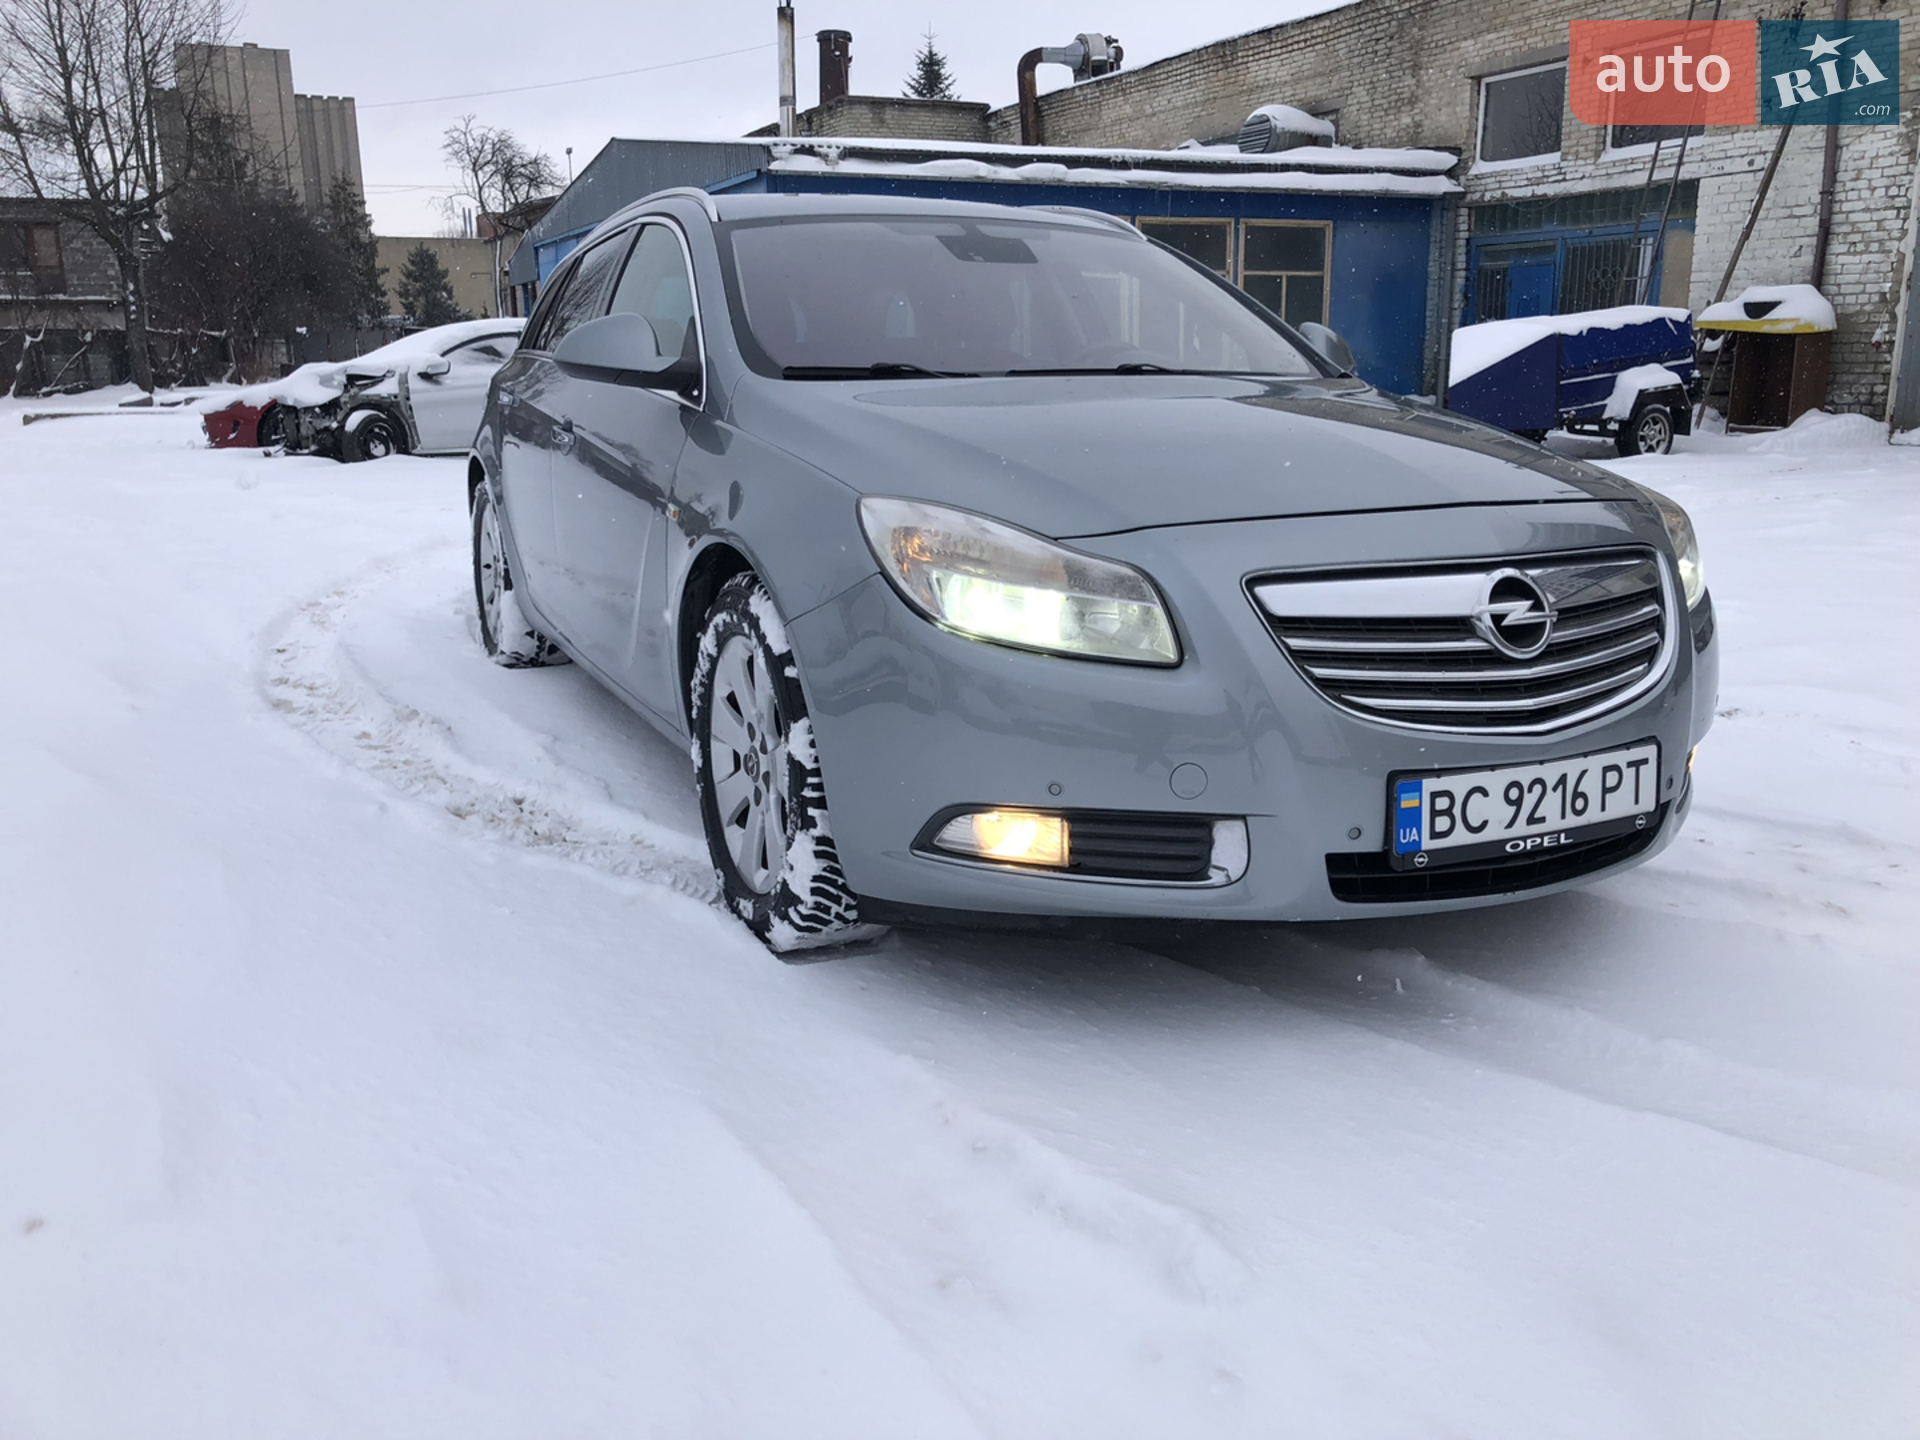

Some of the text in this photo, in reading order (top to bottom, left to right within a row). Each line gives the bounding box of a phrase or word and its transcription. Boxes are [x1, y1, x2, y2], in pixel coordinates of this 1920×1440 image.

[1429, 758, 1649, 840] BC 9216 PT
[1400, 827, 1419, 843] UA
[1504, 833, 1573, 852] OPEL
